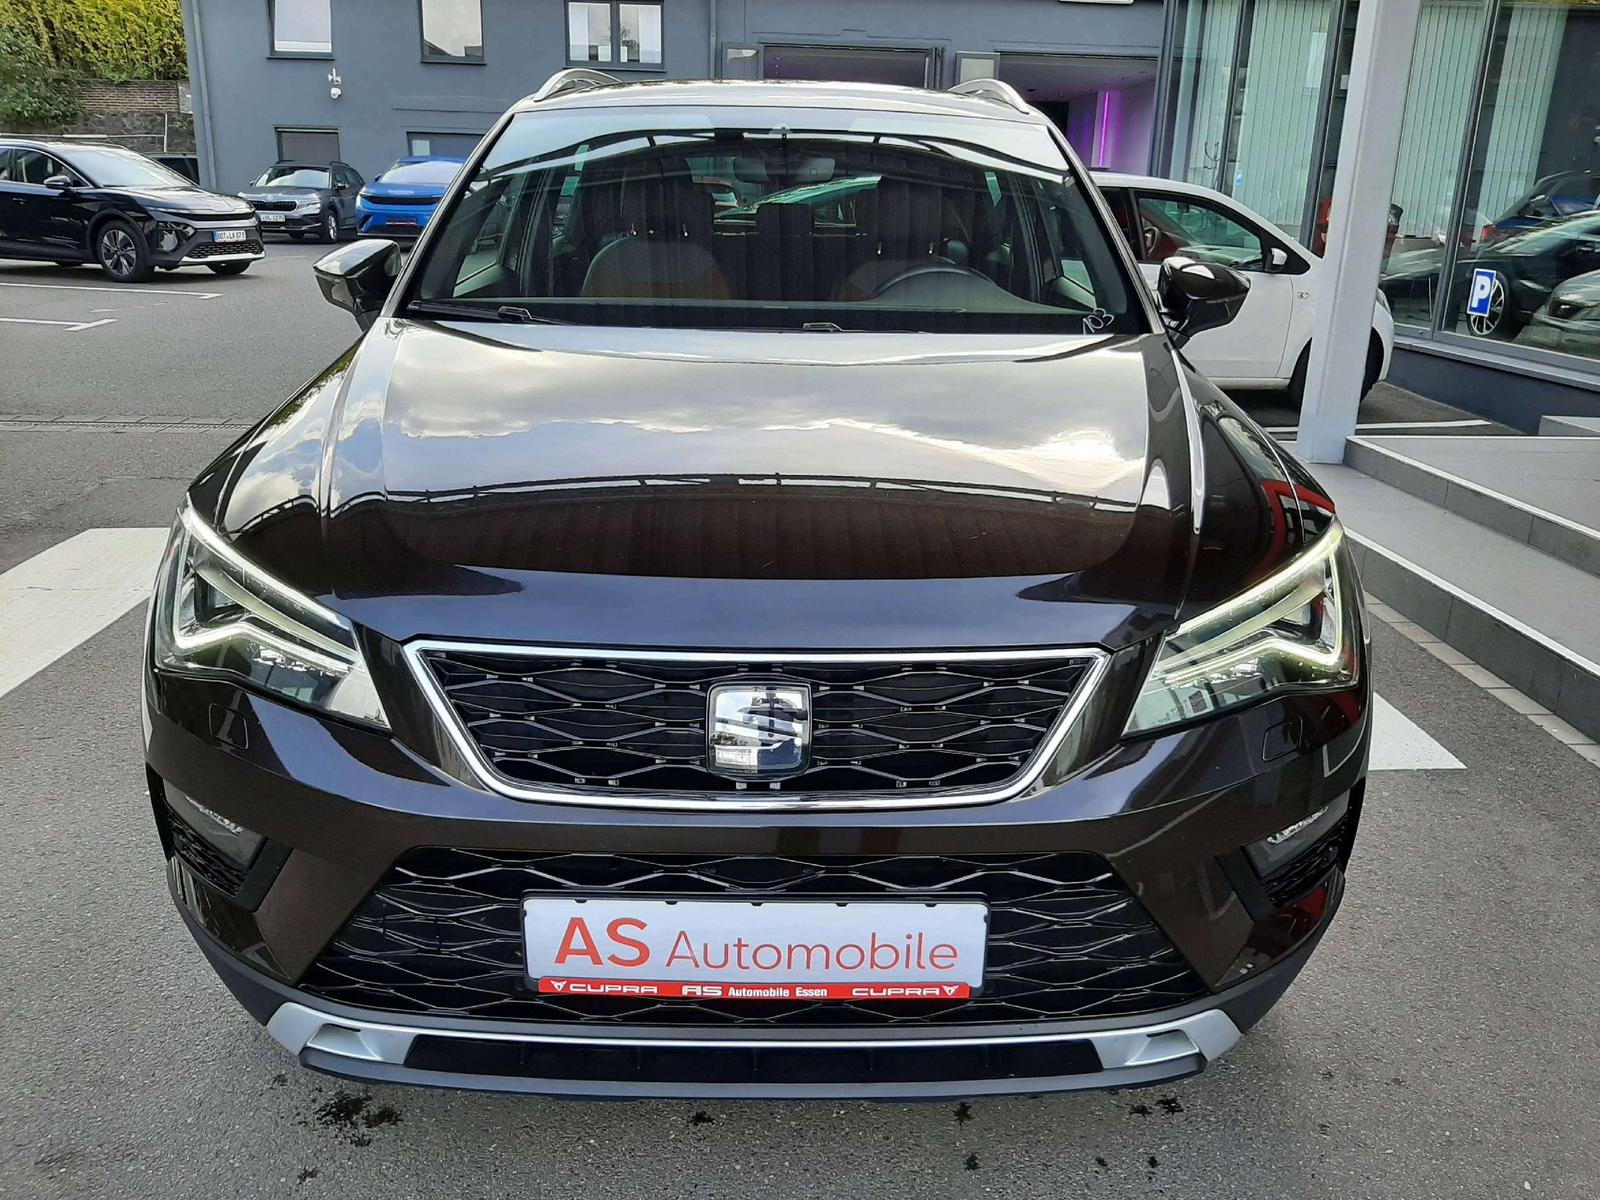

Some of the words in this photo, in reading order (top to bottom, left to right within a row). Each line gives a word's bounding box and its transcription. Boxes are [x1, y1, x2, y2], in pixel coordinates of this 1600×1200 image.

[1471, 275, 1490, 308] P
[1083, 307, 1114, 335] 103
[554, 917, 651, 967] AS
[665, 931, 958, 970] Automobile
[569, 983, 658, 994] CUPRA
[682, 985, 722, 996] AS
[728, 986, 790, 998] Automobile
[795, 986, 828, 997] Essen
[852, 987, 940, 997] CUPRA
